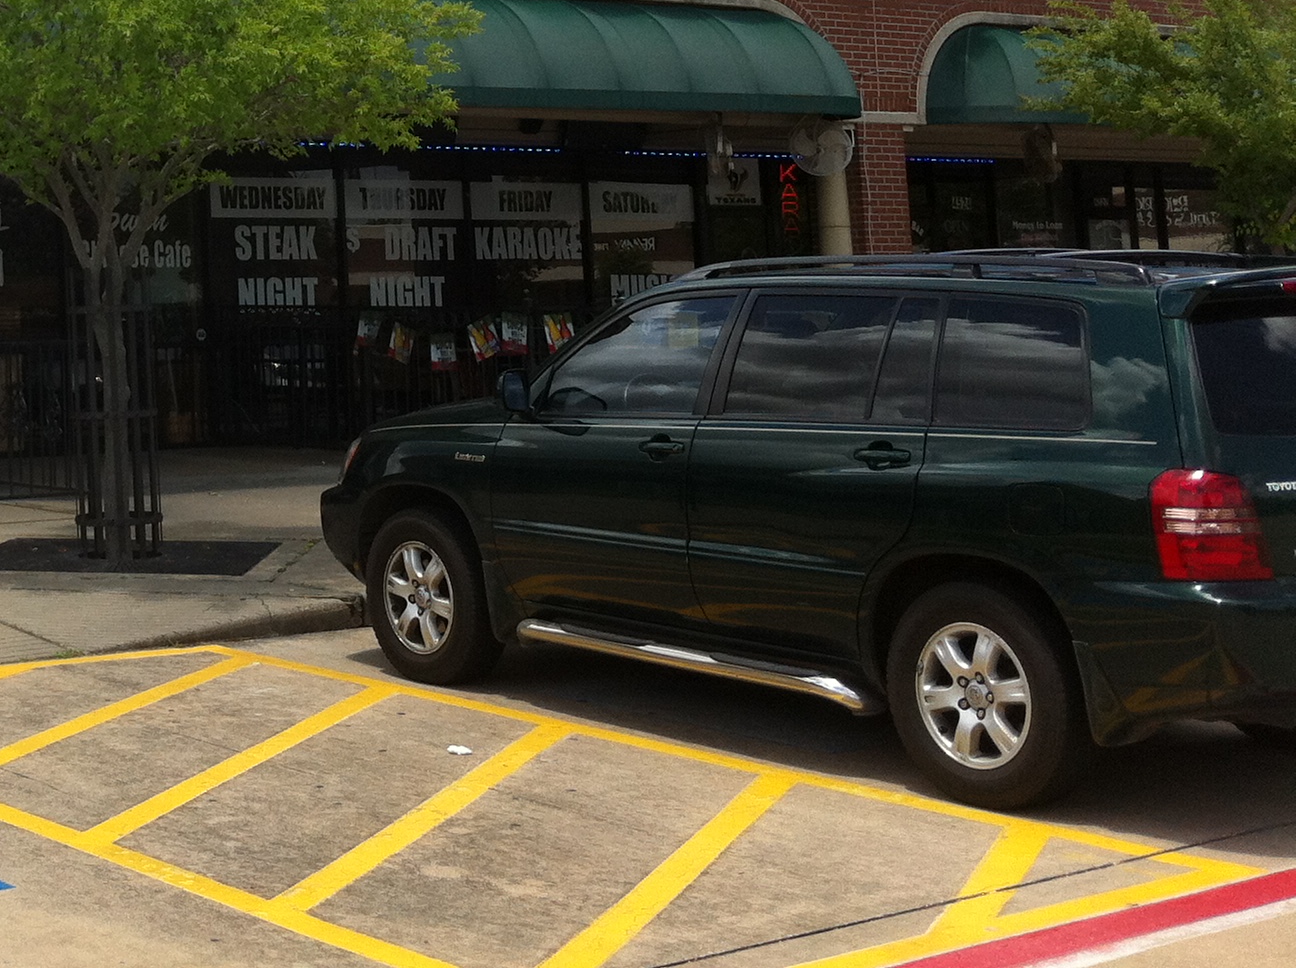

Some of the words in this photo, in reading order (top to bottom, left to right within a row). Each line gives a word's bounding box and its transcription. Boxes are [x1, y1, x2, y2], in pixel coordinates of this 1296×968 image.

[219, 185, 327, 210] WEDNESDAY
[498, 189, 553, 213] FRIDAY
[602, 190, 678, 215] SATUR
[153, 239, 192, 269] Cafe
[234, 223, 319, 262] STEAK
[345, 227, 361, 253] $
[384, 226, 458, 261] DRAFT
[474, 226, 583, 261] KARAOKE
[237, 276, 319, 307] NIGHT
[369, 275, 446, 308] NIGHT
